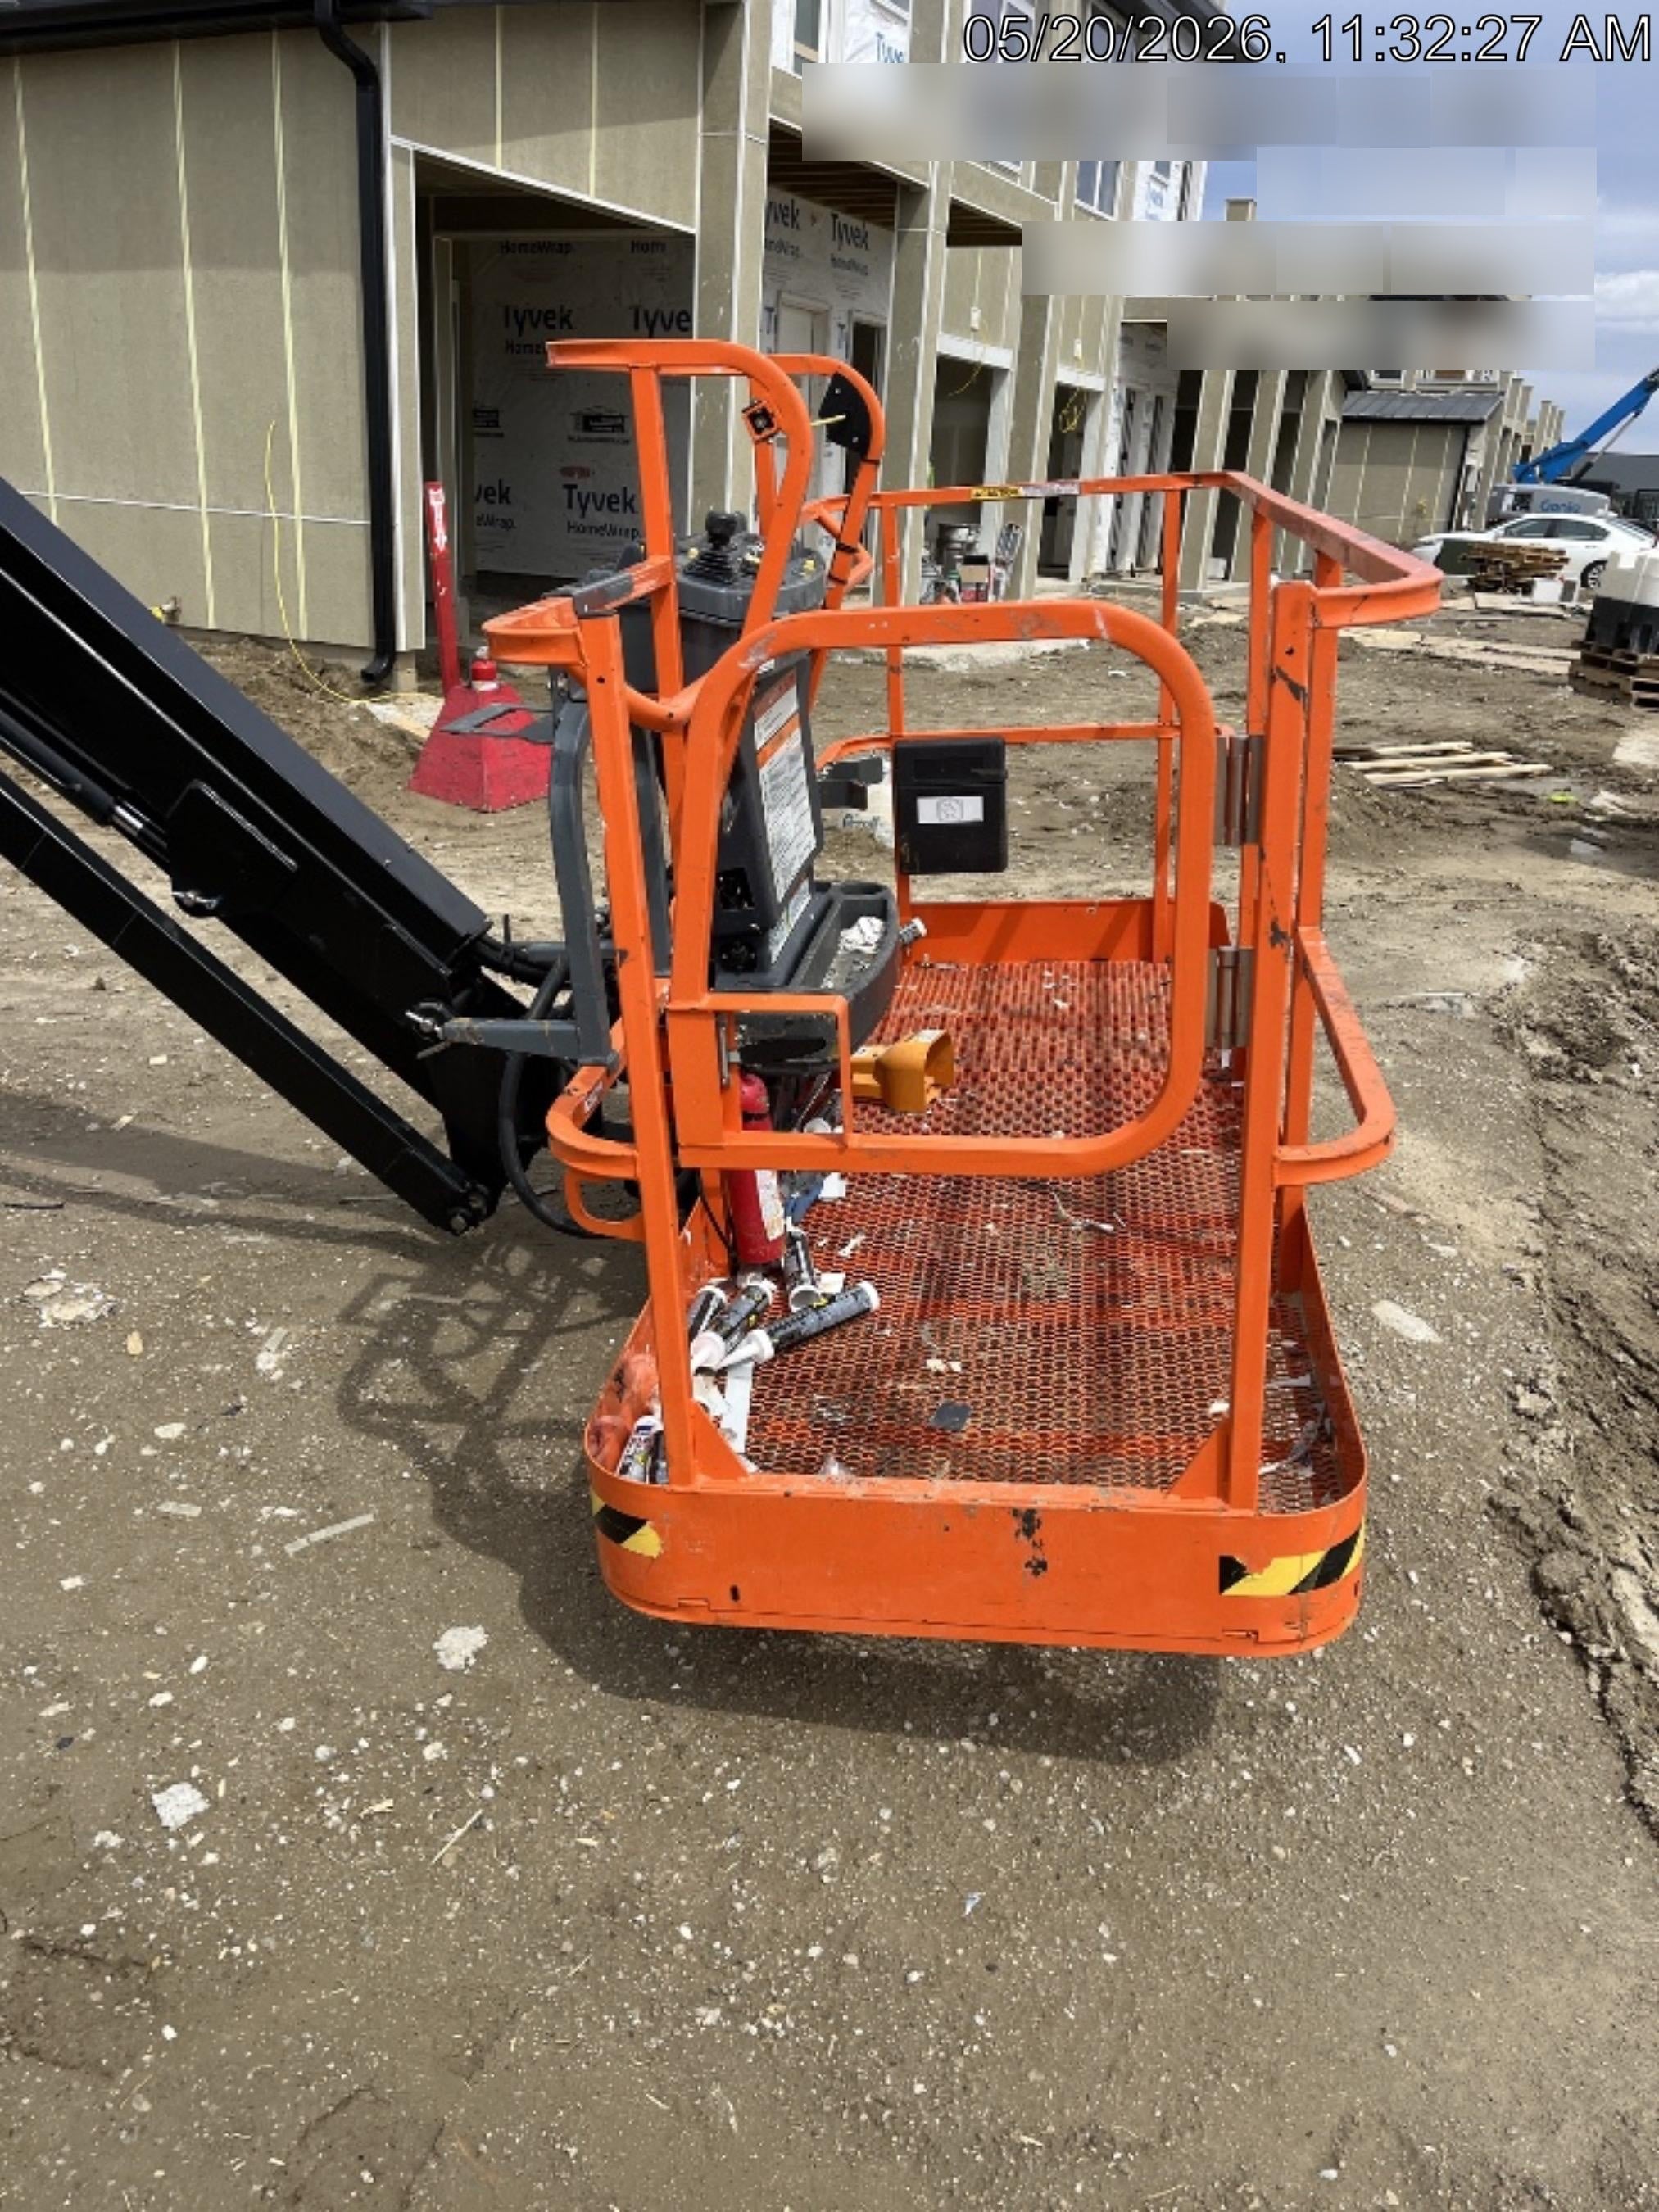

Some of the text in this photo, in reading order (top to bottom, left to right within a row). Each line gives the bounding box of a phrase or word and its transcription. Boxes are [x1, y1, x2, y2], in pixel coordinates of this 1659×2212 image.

[830, 212, 869, 252] Tyvek
[629, 304, 691, 338] Tyve
[562, 483, 637, 519] Tyvek
